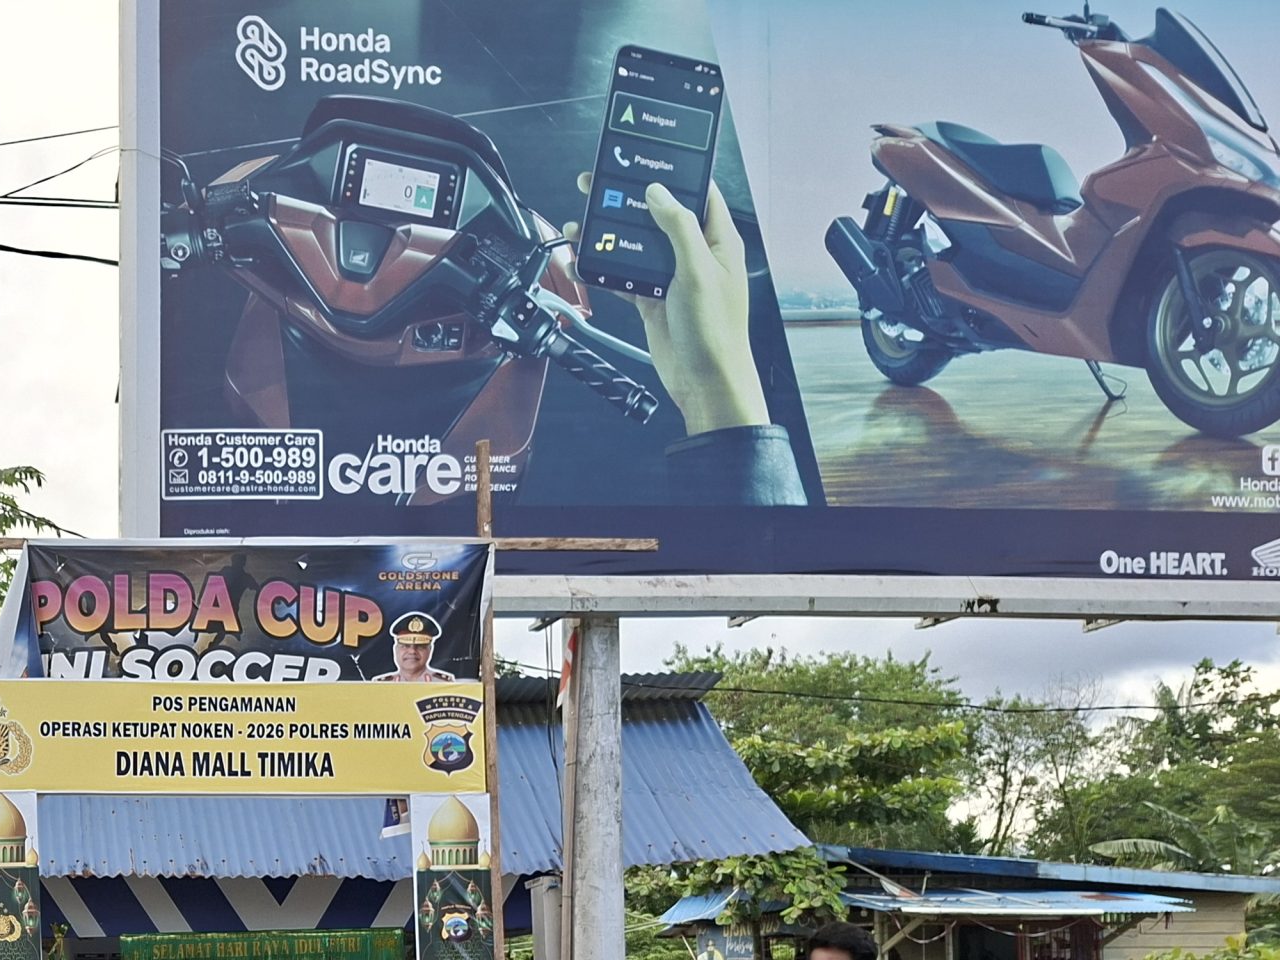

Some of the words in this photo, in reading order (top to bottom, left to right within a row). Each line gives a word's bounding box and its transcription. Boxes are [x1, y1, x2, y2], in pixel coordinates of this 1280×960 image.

[300, 27, 391, 53] Honda
[300, 59, 443, 90] RoadSync
[641, 111, 677, 128] Navigasi
[634, 155, 674, 171] Panggilan
[626, 197, 649, 210] Pesa
[618, 238, 644, 252] Musik
[169, 434, 212, 446] Honda
[216, 434, 281, 446] Customer
[284, 434, 316, 446] Care
[377, 434, 441, 454] Honda
[198, 447, 316, 468] 1-500-989
[198, 470, 316, 484] 0811-9-500-989
[169, 486, 317, 494] customercare@astra-honda.com
[1100, 550, 1146, 574] One
[1149, 551, 1228, 576] HEART.
[378, 570, 460, 581] GOLDSTONE
[395, 581, 442, 591] ARENA
[31, 572, 241, 635] POLDA
[256, 580, 384, 648] CUP
[152, 696, 184, 712] POS
[187, 696, 297, 713] PENGAMANAN
[424, 711, 447, 721] PAPUA
[447, 711, 474, 721] TENGAH
[39, 721, 107, 738] OPERASI
[111, 722, 177, 738] KETUPAT
[180, 723, 234, 739] NOKEN
[246, 723, 285, 739] 2026
[289, 723, 349, 739] POLRES
[353, 723, 412, 740] MIMIKA
[116, 751, 186, 777] DIANA
[192, 751, 252, 777] MALL
[257, 752, 335, 778] TIMIKA
[152, 943, 213, 960] SELAMAT
[216, 940, 249, 958] HARI
[253, 939, 290, 956] RAYA
